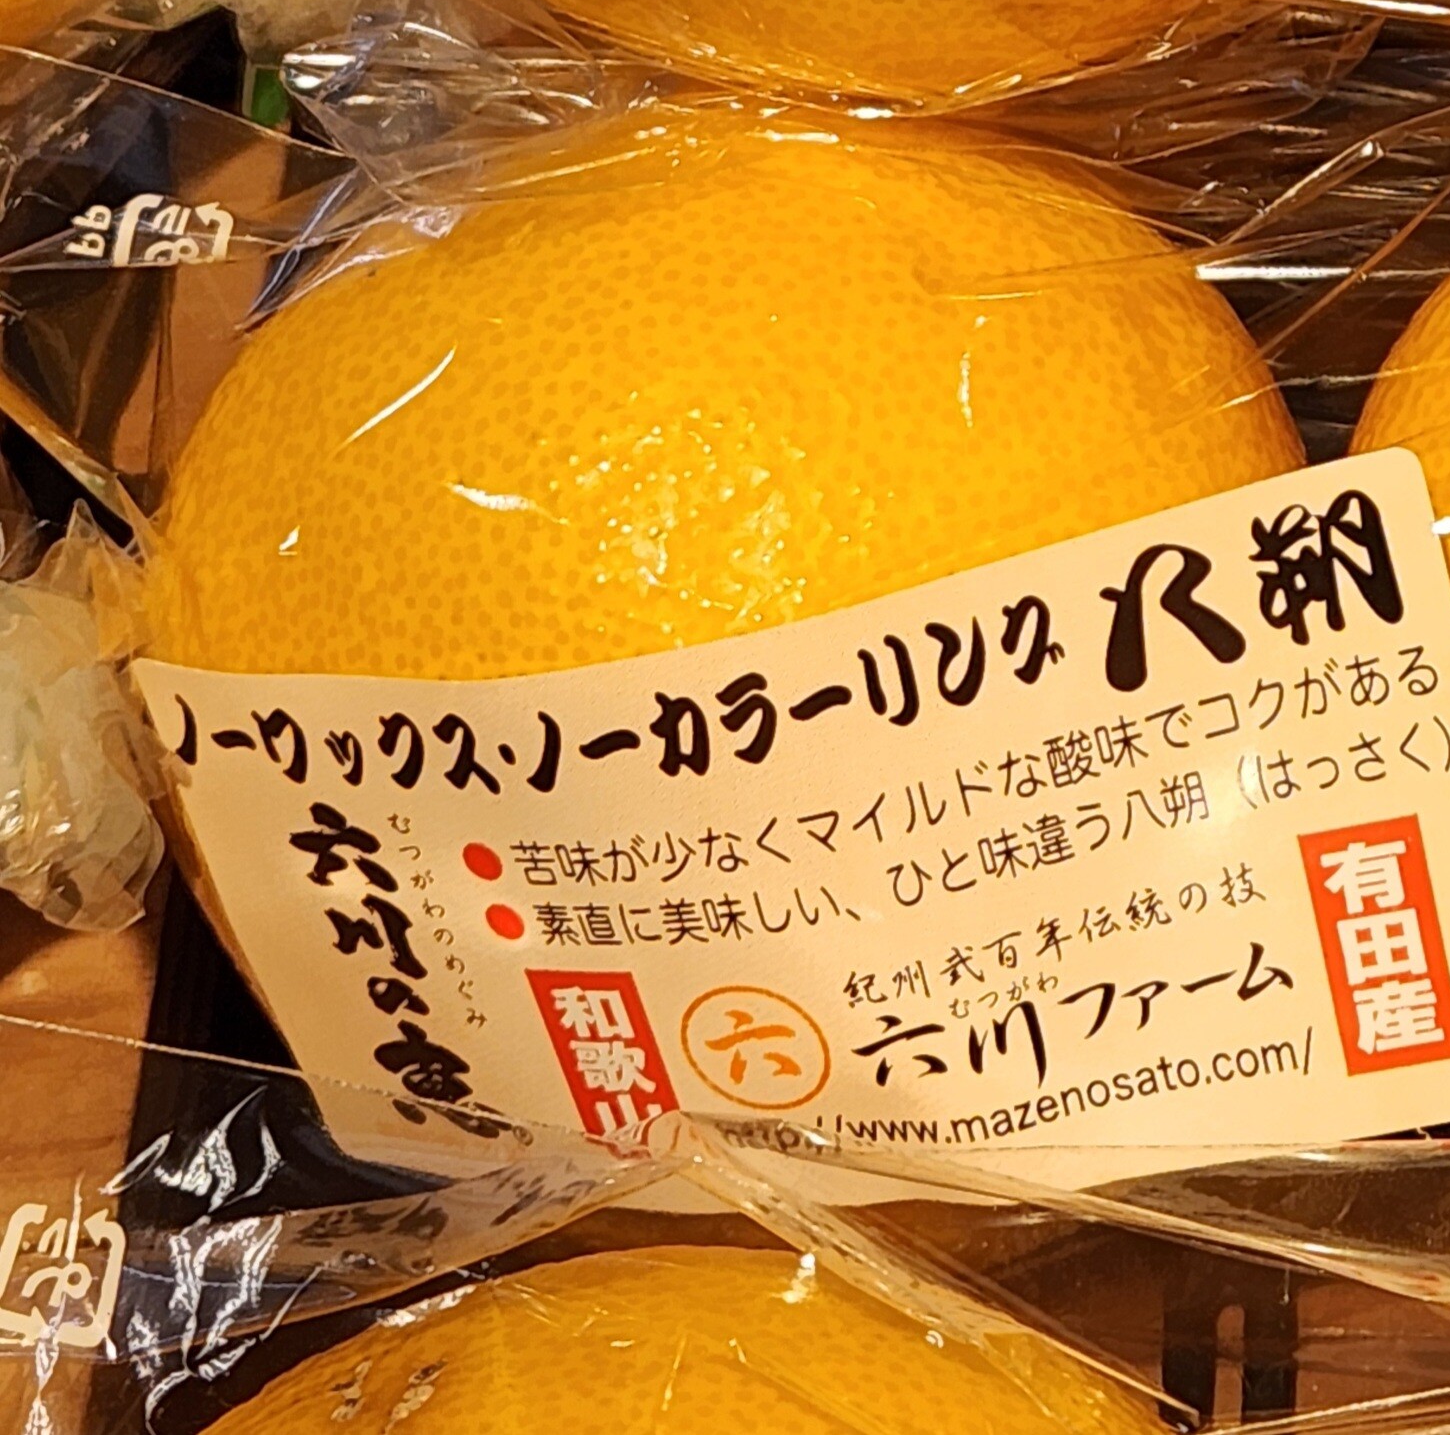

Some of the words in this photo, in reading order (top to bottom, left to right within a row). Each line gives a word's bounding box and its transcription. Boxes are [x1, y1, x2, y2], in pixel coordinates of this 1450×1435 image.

[1100, 489, 1404, 692] 八朔
[510, 645, 1438, 889] 苦味が少なくマイルドな酸味でコクがある
[387, 812, 487, 1030] むつがわのめぐみ
[851, 941, 1294, 1089] 六川ファーム
[949, 972, 1059, 1020] むつがわ
[1320, 840, 1445, 1055] 有田産
